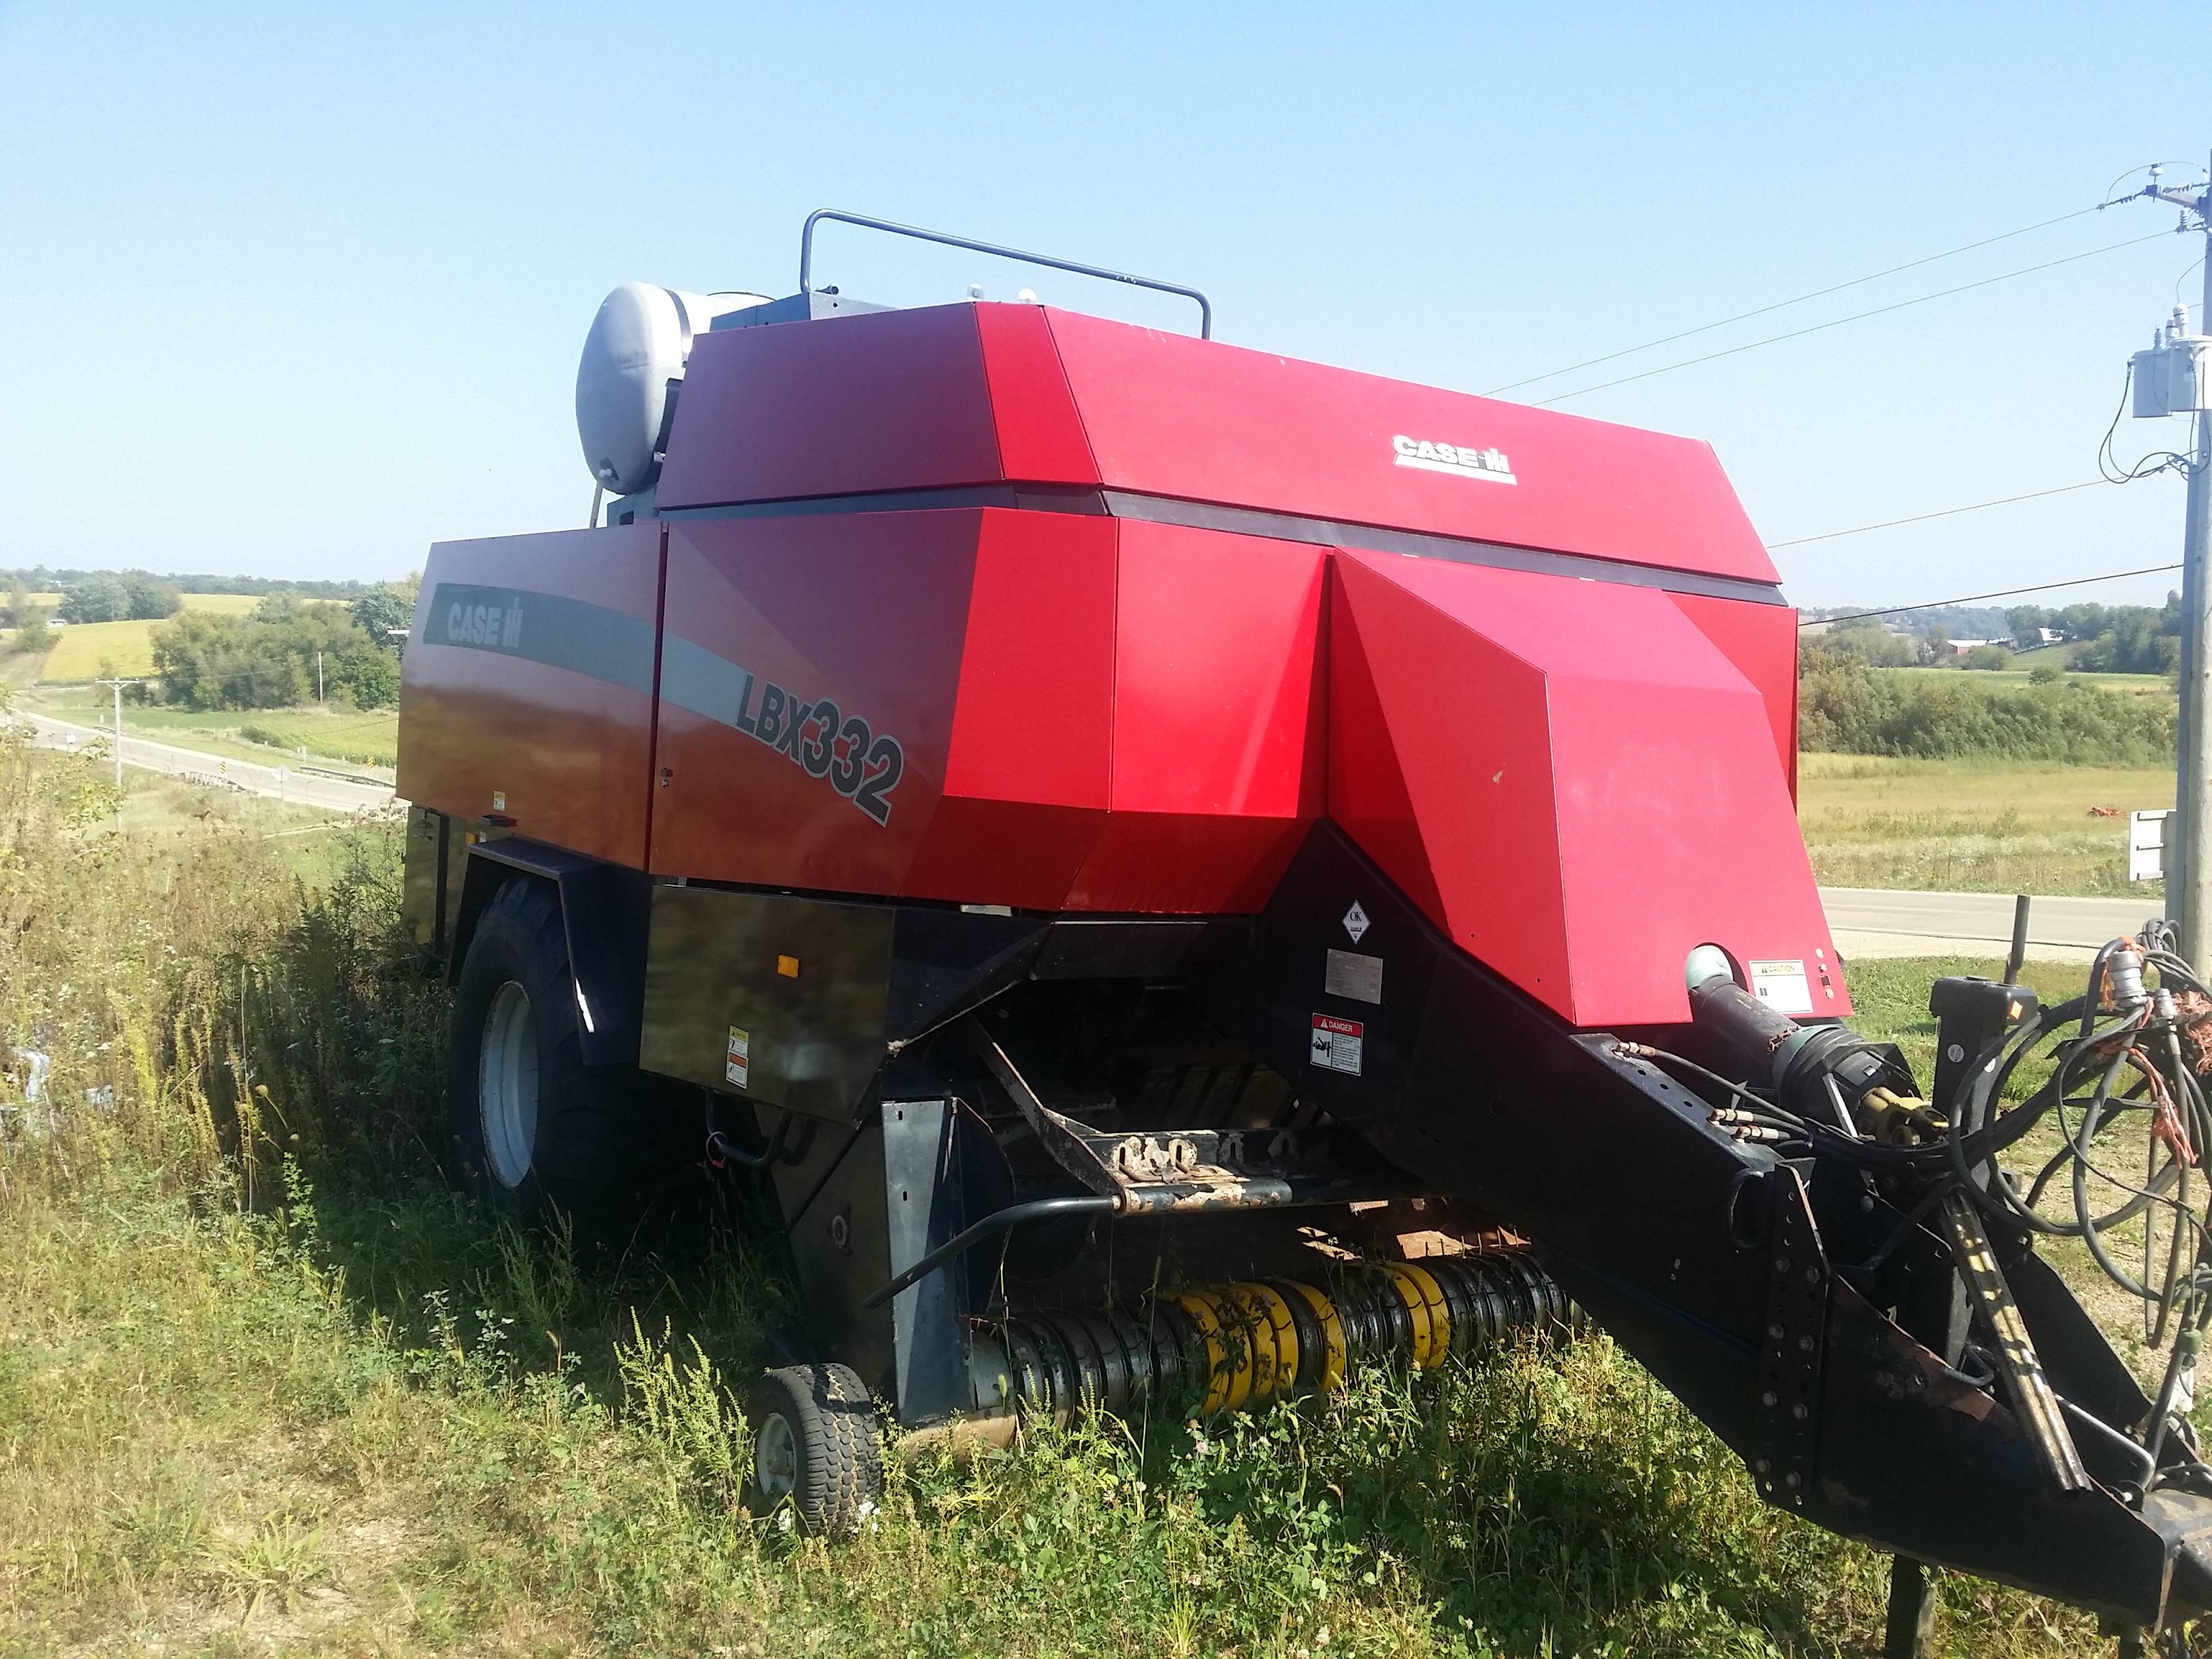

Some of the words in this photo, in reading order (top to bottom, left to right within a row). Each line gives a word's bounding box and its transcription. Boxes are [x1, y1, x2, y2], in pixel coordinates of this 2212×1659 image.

[1393, 434, 1479, 468] CASE
[448, 602, 502, 645] CASE
[735, 674, 904, 827] LBX332
[1350, 912, 1361, 921] OK
[1328, 1021, 1353, 1032] DANGER
